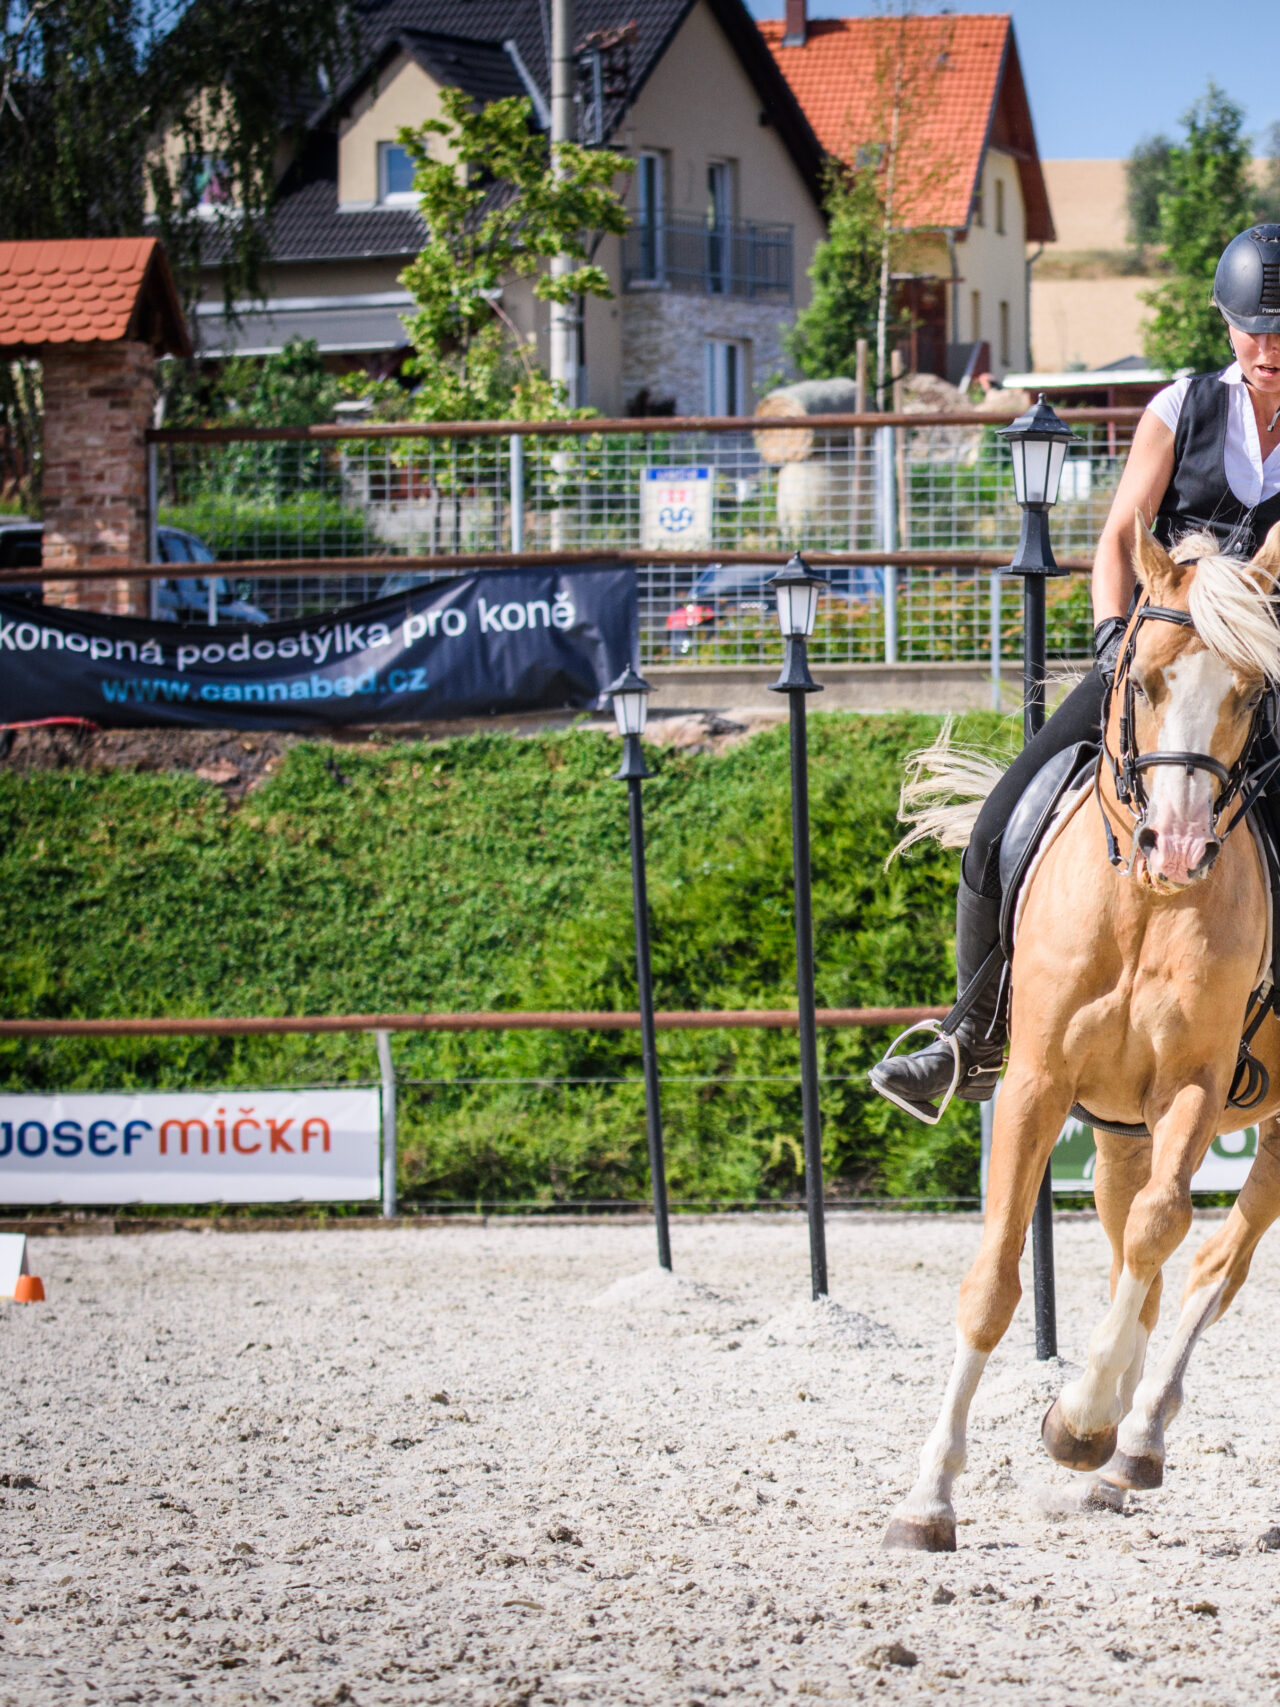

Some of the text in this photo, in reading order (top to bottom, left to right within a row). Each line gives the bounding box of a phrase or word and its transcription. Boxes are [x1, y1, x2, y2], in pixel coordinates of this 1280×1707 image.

[0, 590, 577, 672] konopná podostýlka pro koně
[100, 666, 429, 703] www.cannabed.cz
